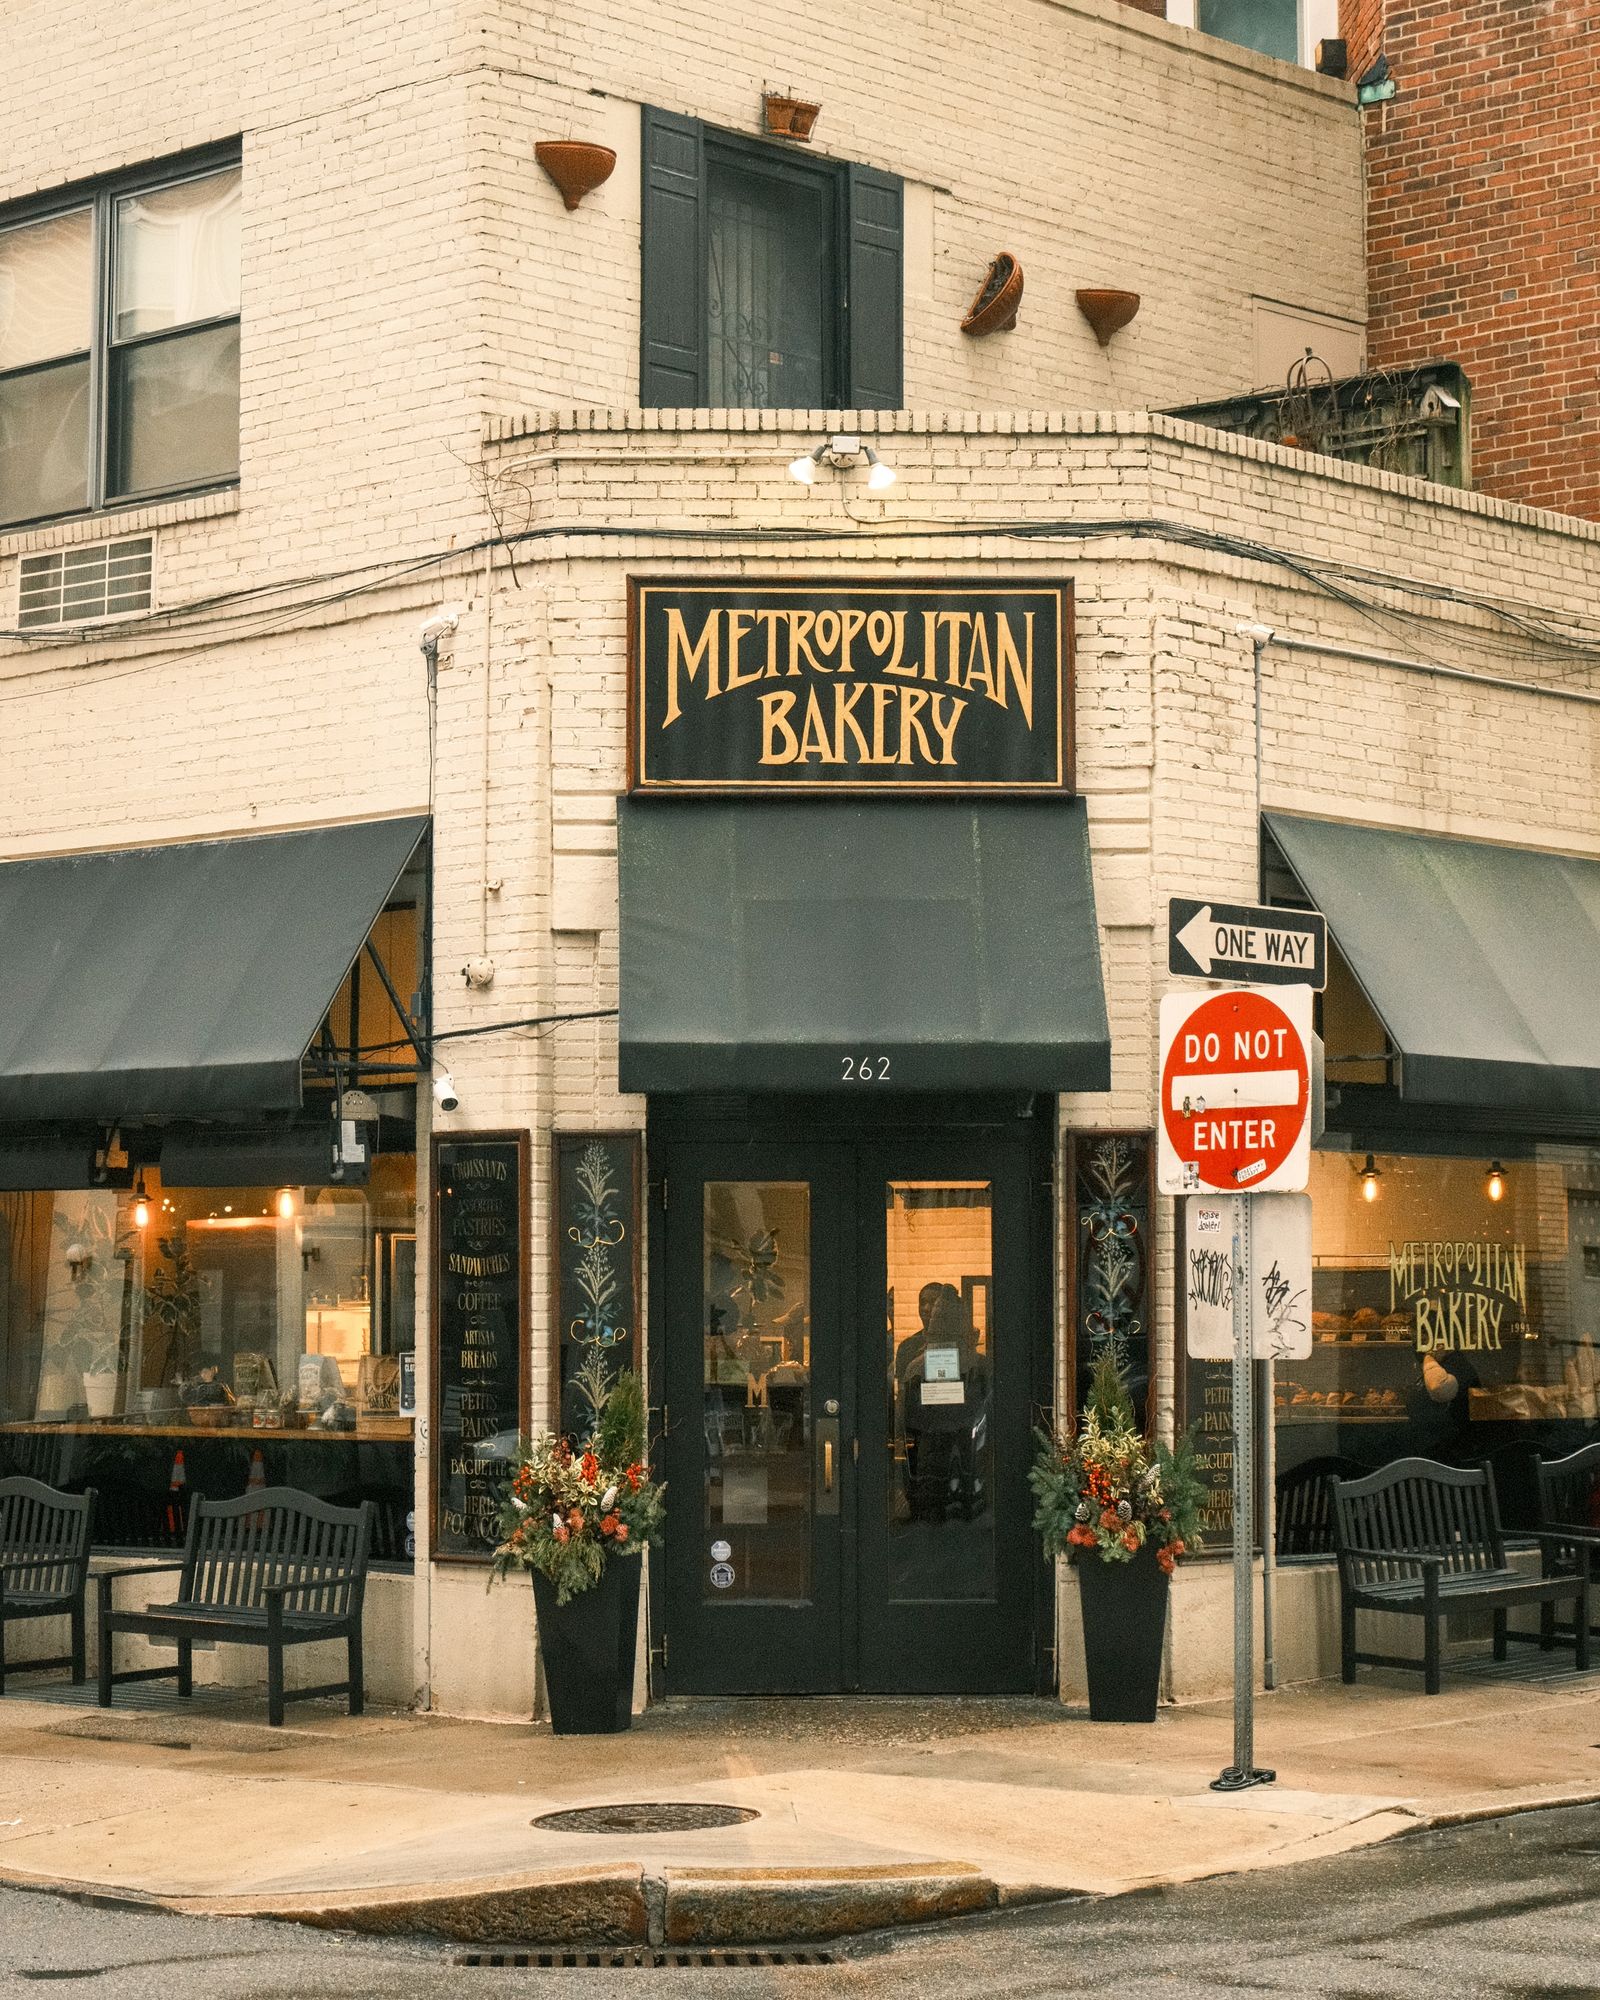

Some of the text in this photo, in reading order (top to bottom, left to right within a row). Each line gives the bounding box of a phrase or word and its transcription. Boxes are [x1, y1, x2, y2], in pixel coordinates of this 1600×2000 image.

[662, 607, 1036, 732] METROPOLITAN
[757, 683, 968, 766] BAKERY
[1214, 926, 1309, 965] ONE WAY
[1184, 1028, 1288, 1064] DO NOT
[841, 1056, 890, 1080] 262
[1193, 1117, 1277, 1151] ENTER
[452, 1158, 508, 1182] CROISSANTS
[453, 1217, 507, 1236] PASTRIES
[449, 1252, 511, 1278] SANDWICHES
[1388, 1241, 1527, 1316] METROPOLITAN
[458, 1292, 502, 1311] COFFEE
[1416, 1291, 1504, 1352] BAKERY
[463, 1330, 496, 1346] ARTISAN
[461, 1350, 499, 1370] BREADS
[744, 1371, 769, 1408] M
[460, 1417, 500, 1438] PAINS
[451, 1458, 508, 1477] BAGUETTE
